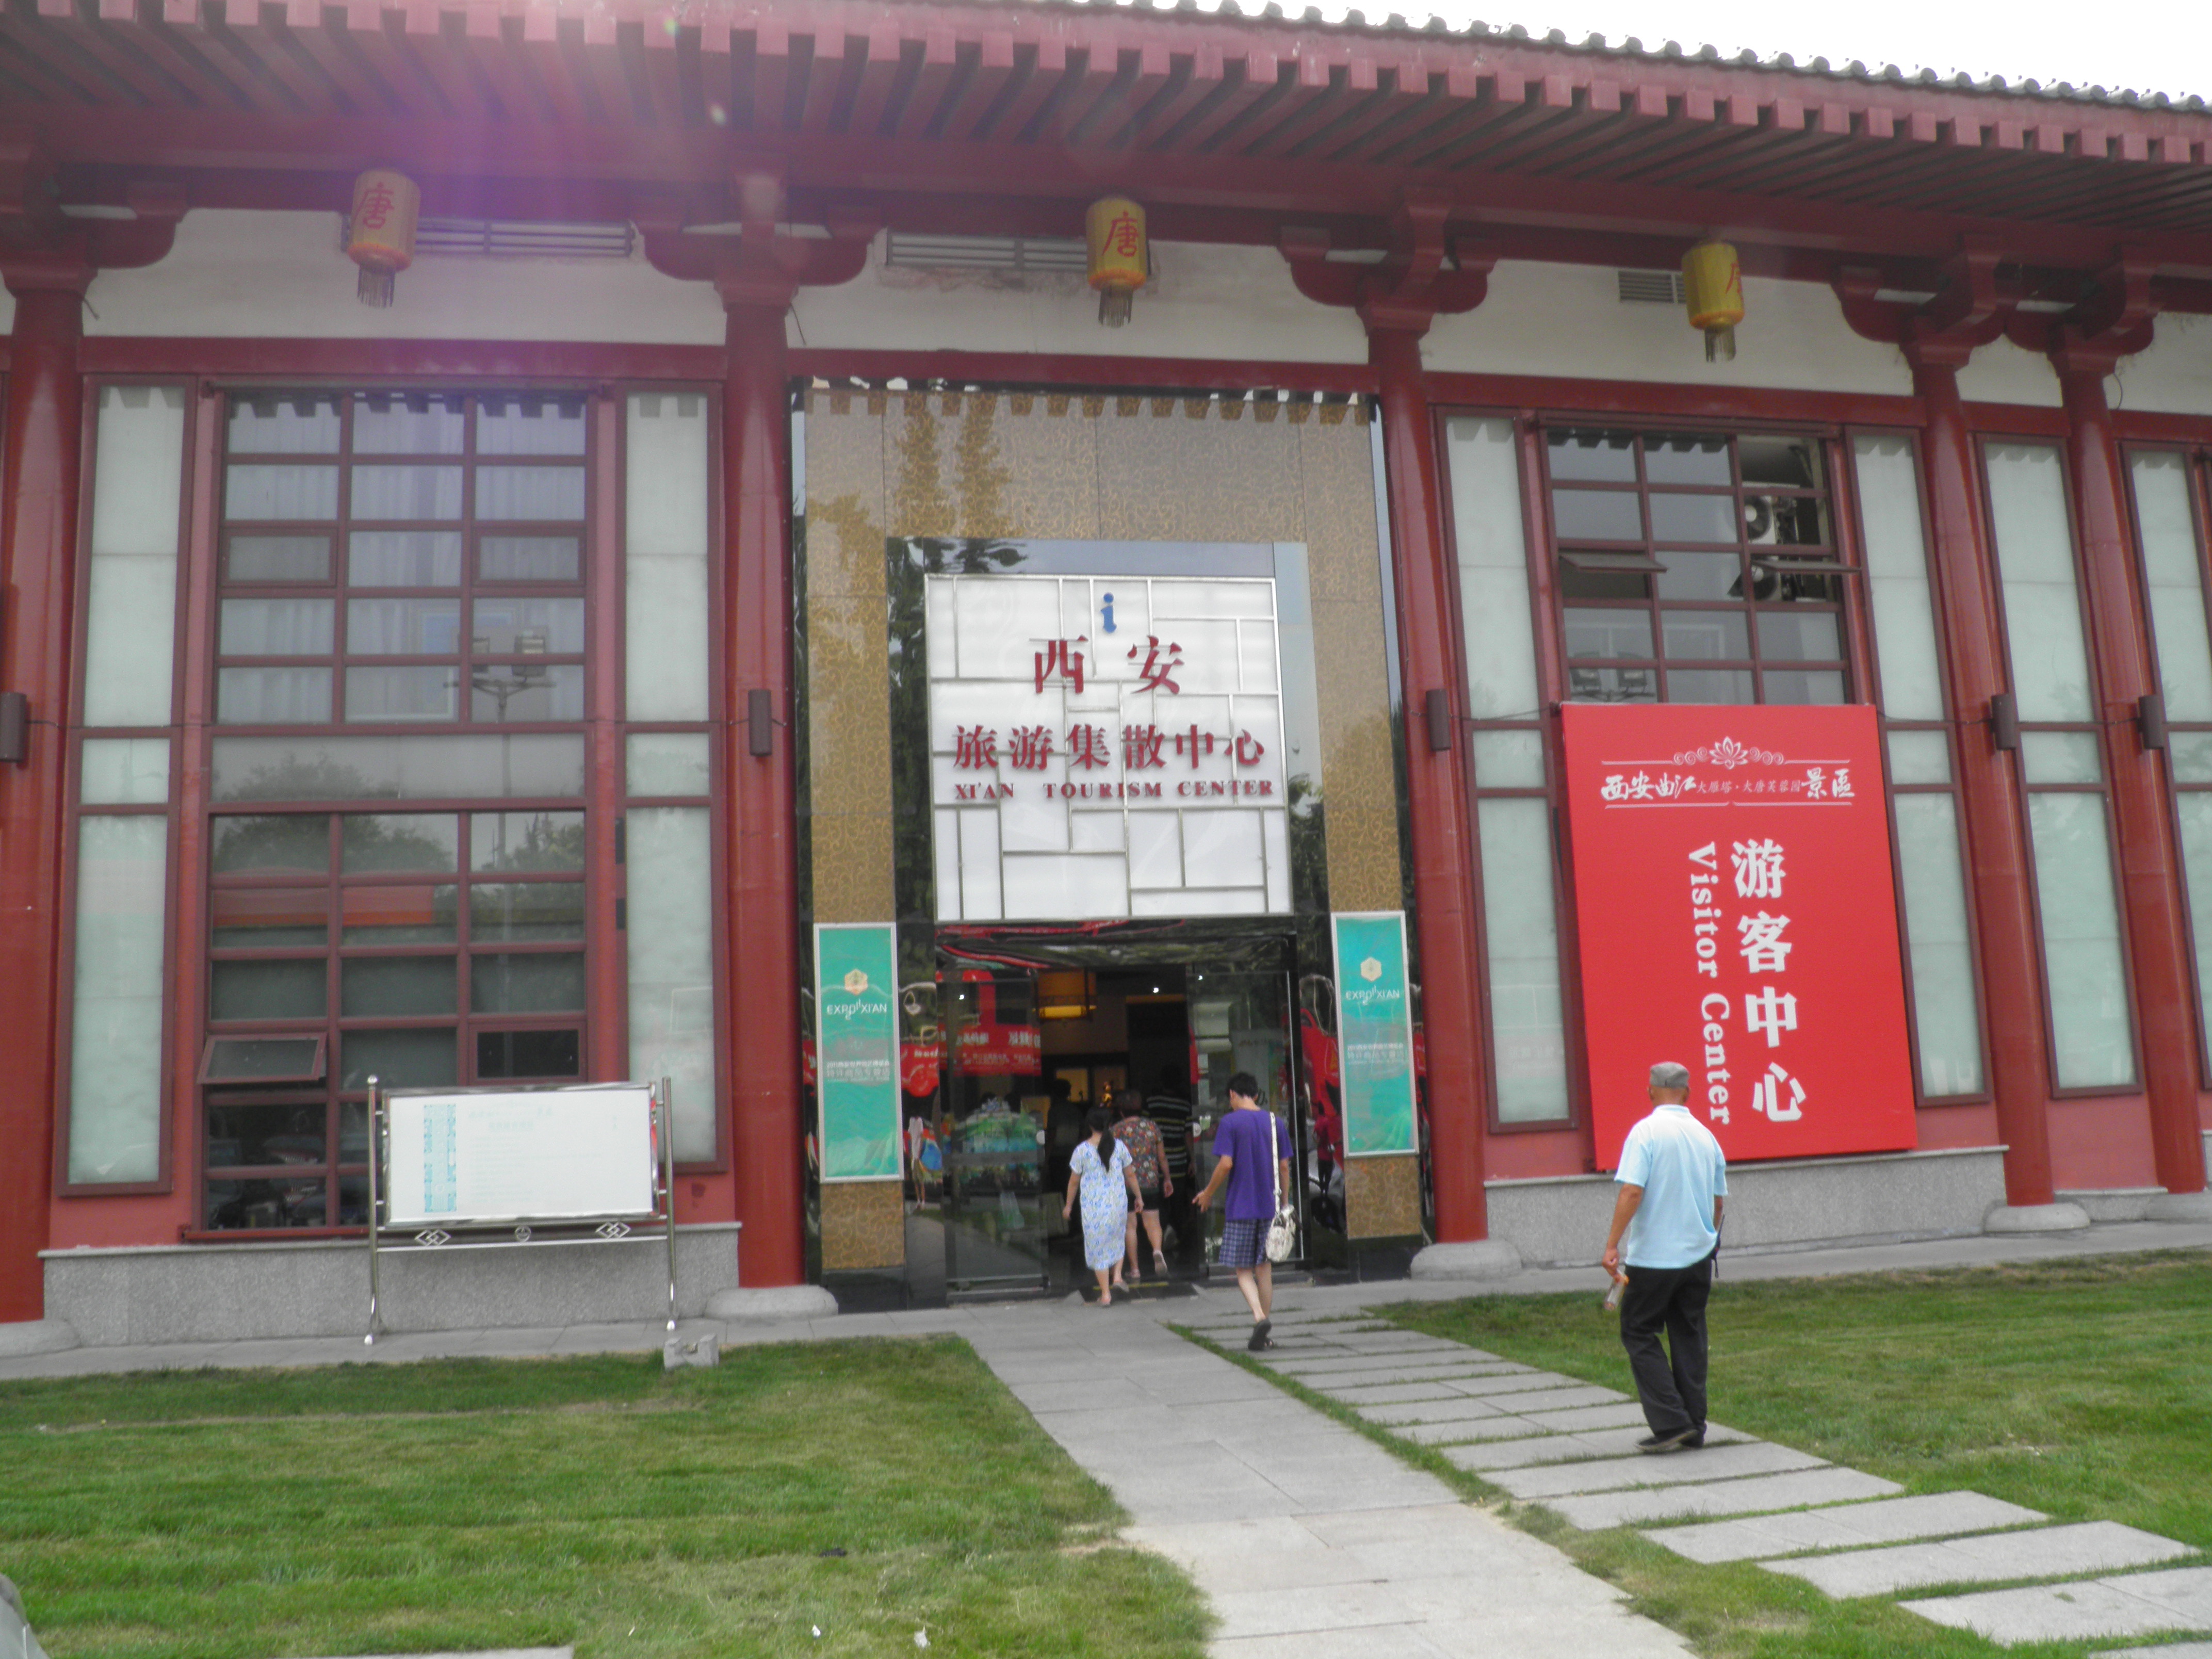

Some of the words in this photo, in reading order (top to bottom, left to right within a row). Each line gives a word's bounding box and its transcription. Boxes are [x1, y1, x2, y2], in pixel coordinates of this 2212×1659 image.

[356, 182, 394, 230] 唐
[1102, 210, 1139, 257] 唐
[1030, 635, 1184, 695] 西安
[953, 724, 1265, 771] 旅游集散中心
[955, 783, 1015, 800] XI'AN
[1043, 782, 1162, 799] TOURISM
[1178, 779, 1273, 796] CENTER
[1688, 841, 1722, 978] Visitor
[1731, 838, 1807, 1124] 游客中心
[1701, 993, 1730, 1125] Center
